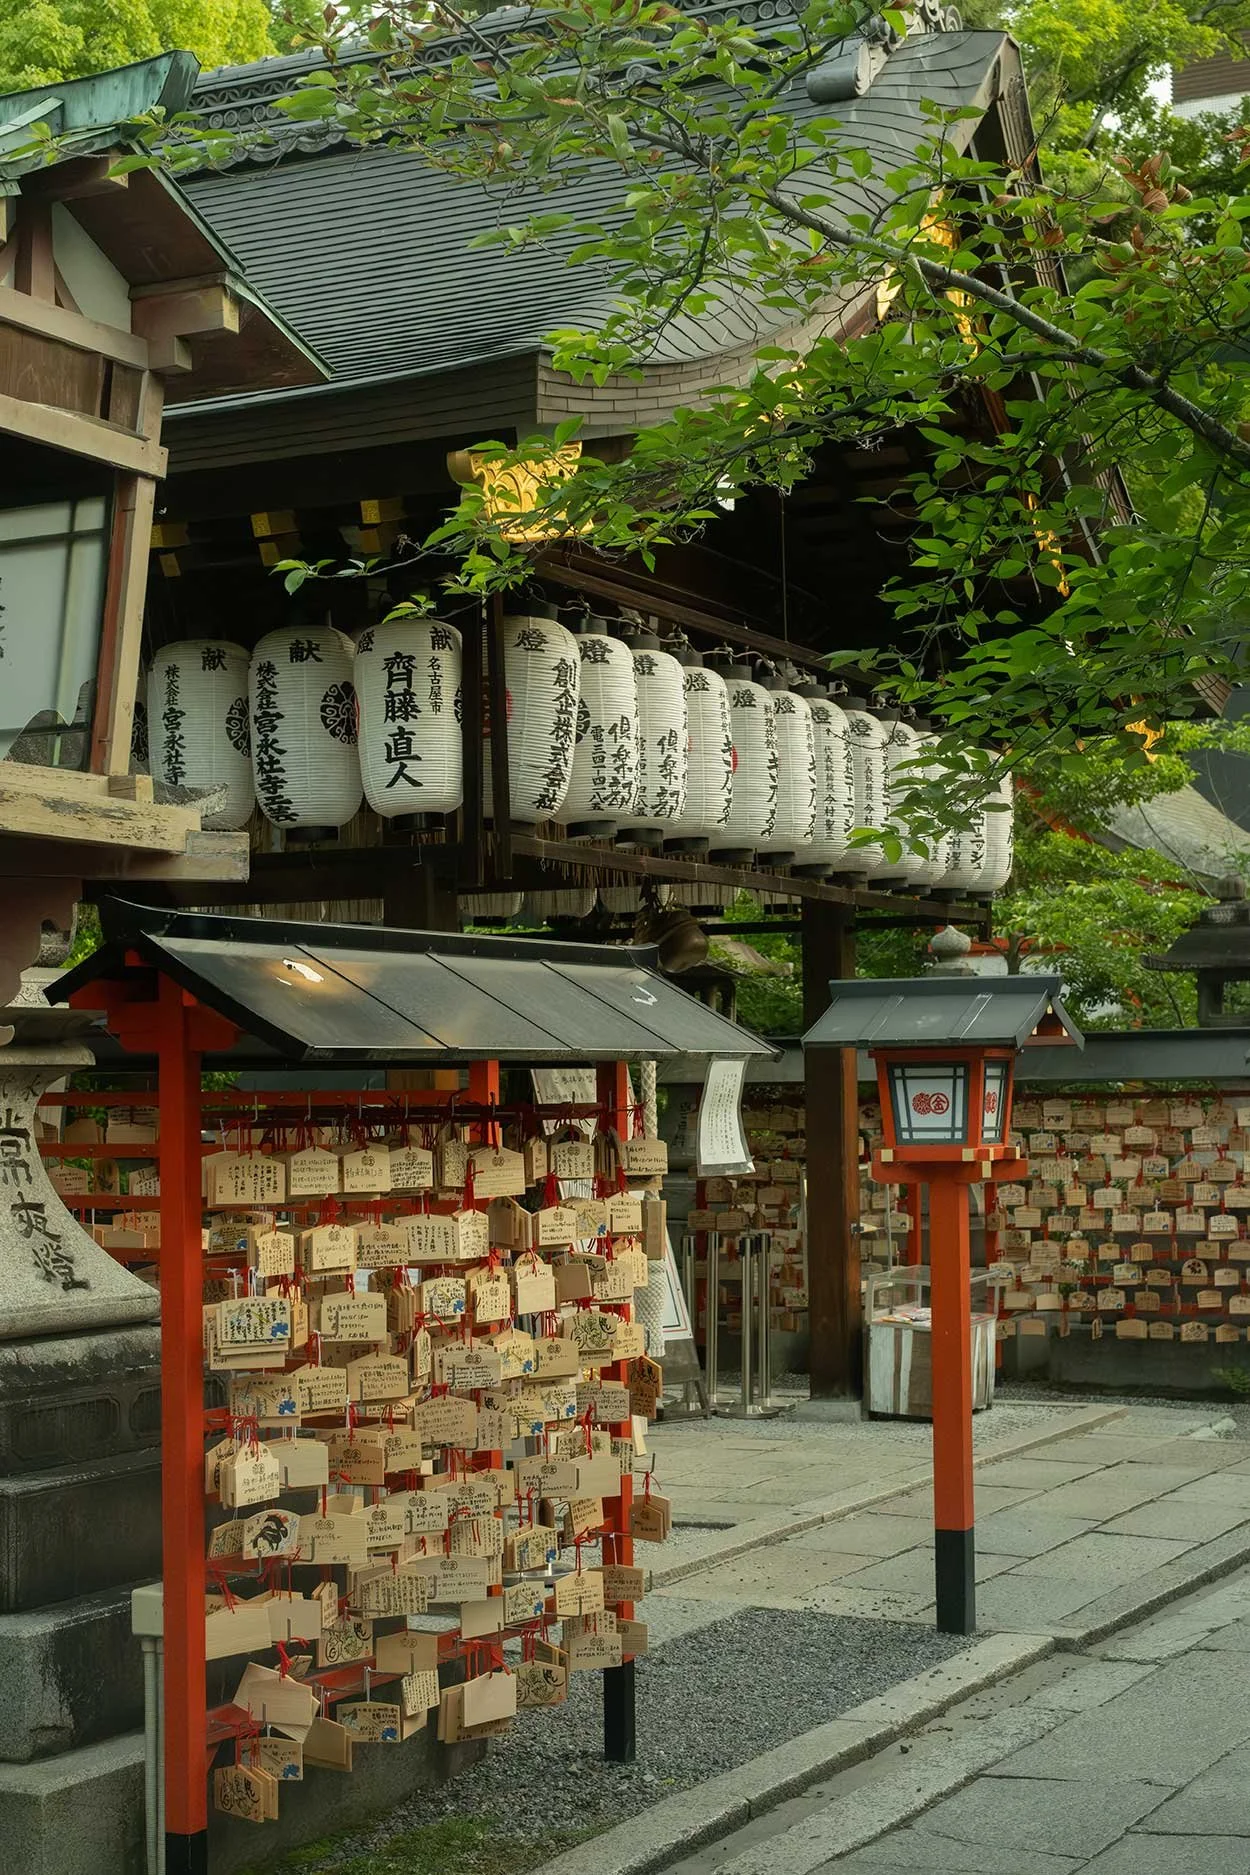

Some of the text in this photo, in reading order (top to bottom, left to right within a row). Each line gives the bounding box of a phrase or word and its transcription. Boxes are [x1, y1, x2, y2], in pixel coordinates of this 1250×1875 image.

[289, 638, 324, 664] 献
[429, 626, 454, 651] 献
[201, 647, 227, 672] 献
[427, 656, 444, 716] 名古屋市
[161, 664, 187, 786] 株式会社宮永社寺
